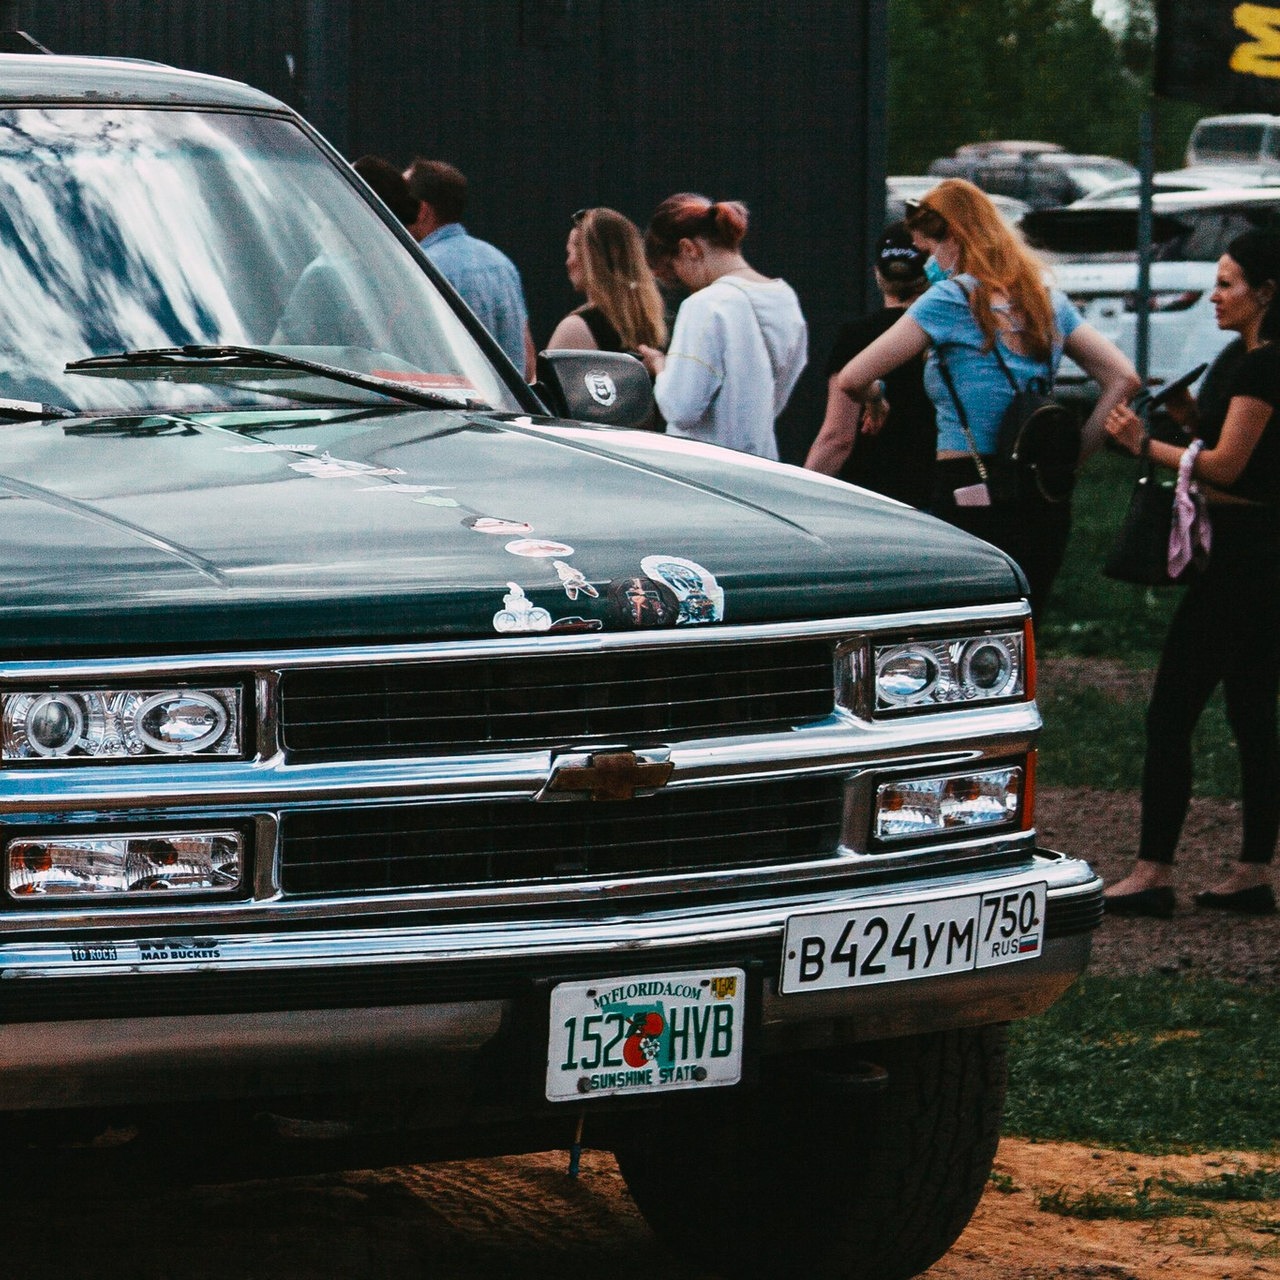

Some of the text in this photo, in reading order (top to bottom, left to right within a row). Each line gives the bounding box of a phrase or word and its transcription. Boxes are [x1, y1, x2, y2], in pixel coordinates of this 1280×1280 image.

[983, 891, 1037, 942] 750
[72, 949, 117, 960] TO ROCK
[141, 950, 221, 961] MAD BUCKETS
[991, 939, 1019, 958] RUS
[593, 981, 702, 1010] MYFLORIDA.COM
[561, 1003, 734, 1071] 152 HVB
[590, 1068, 653, 1090] SUNSHINE
